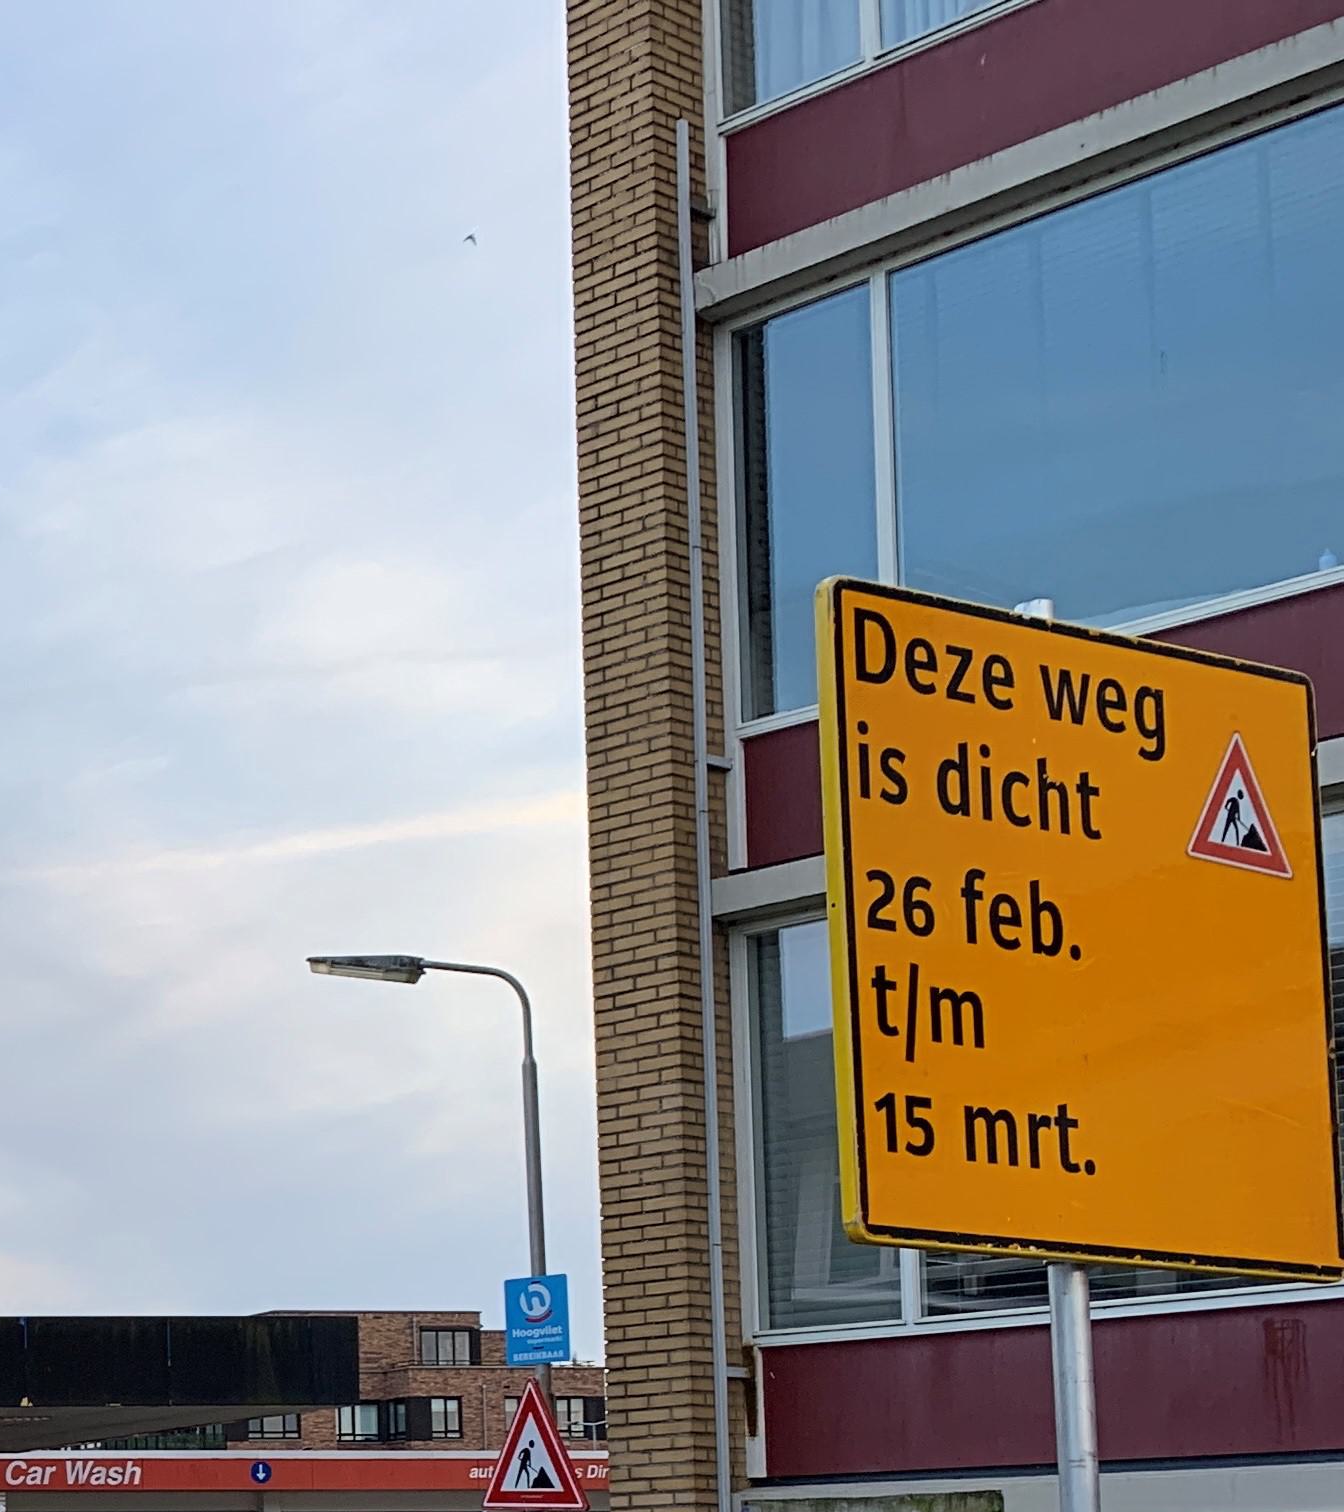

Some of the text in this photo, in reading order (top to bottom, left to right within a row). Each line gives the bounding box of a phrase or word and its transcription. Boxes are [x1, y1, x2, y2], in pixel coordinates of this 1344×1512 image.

[854, 607, 1166, 762] Deze weg
[857, 720, 1102, 840] is dicht
[866, 868, 1082, 961] 26 feb.
[871, 962, 985, 1063] t/m
[874, 1092, 1096, 1176] 15 mrt.
[512, 1325, 564, 1338] Hoogvliet
[5, 1460, 142, 1485] Car Wash
